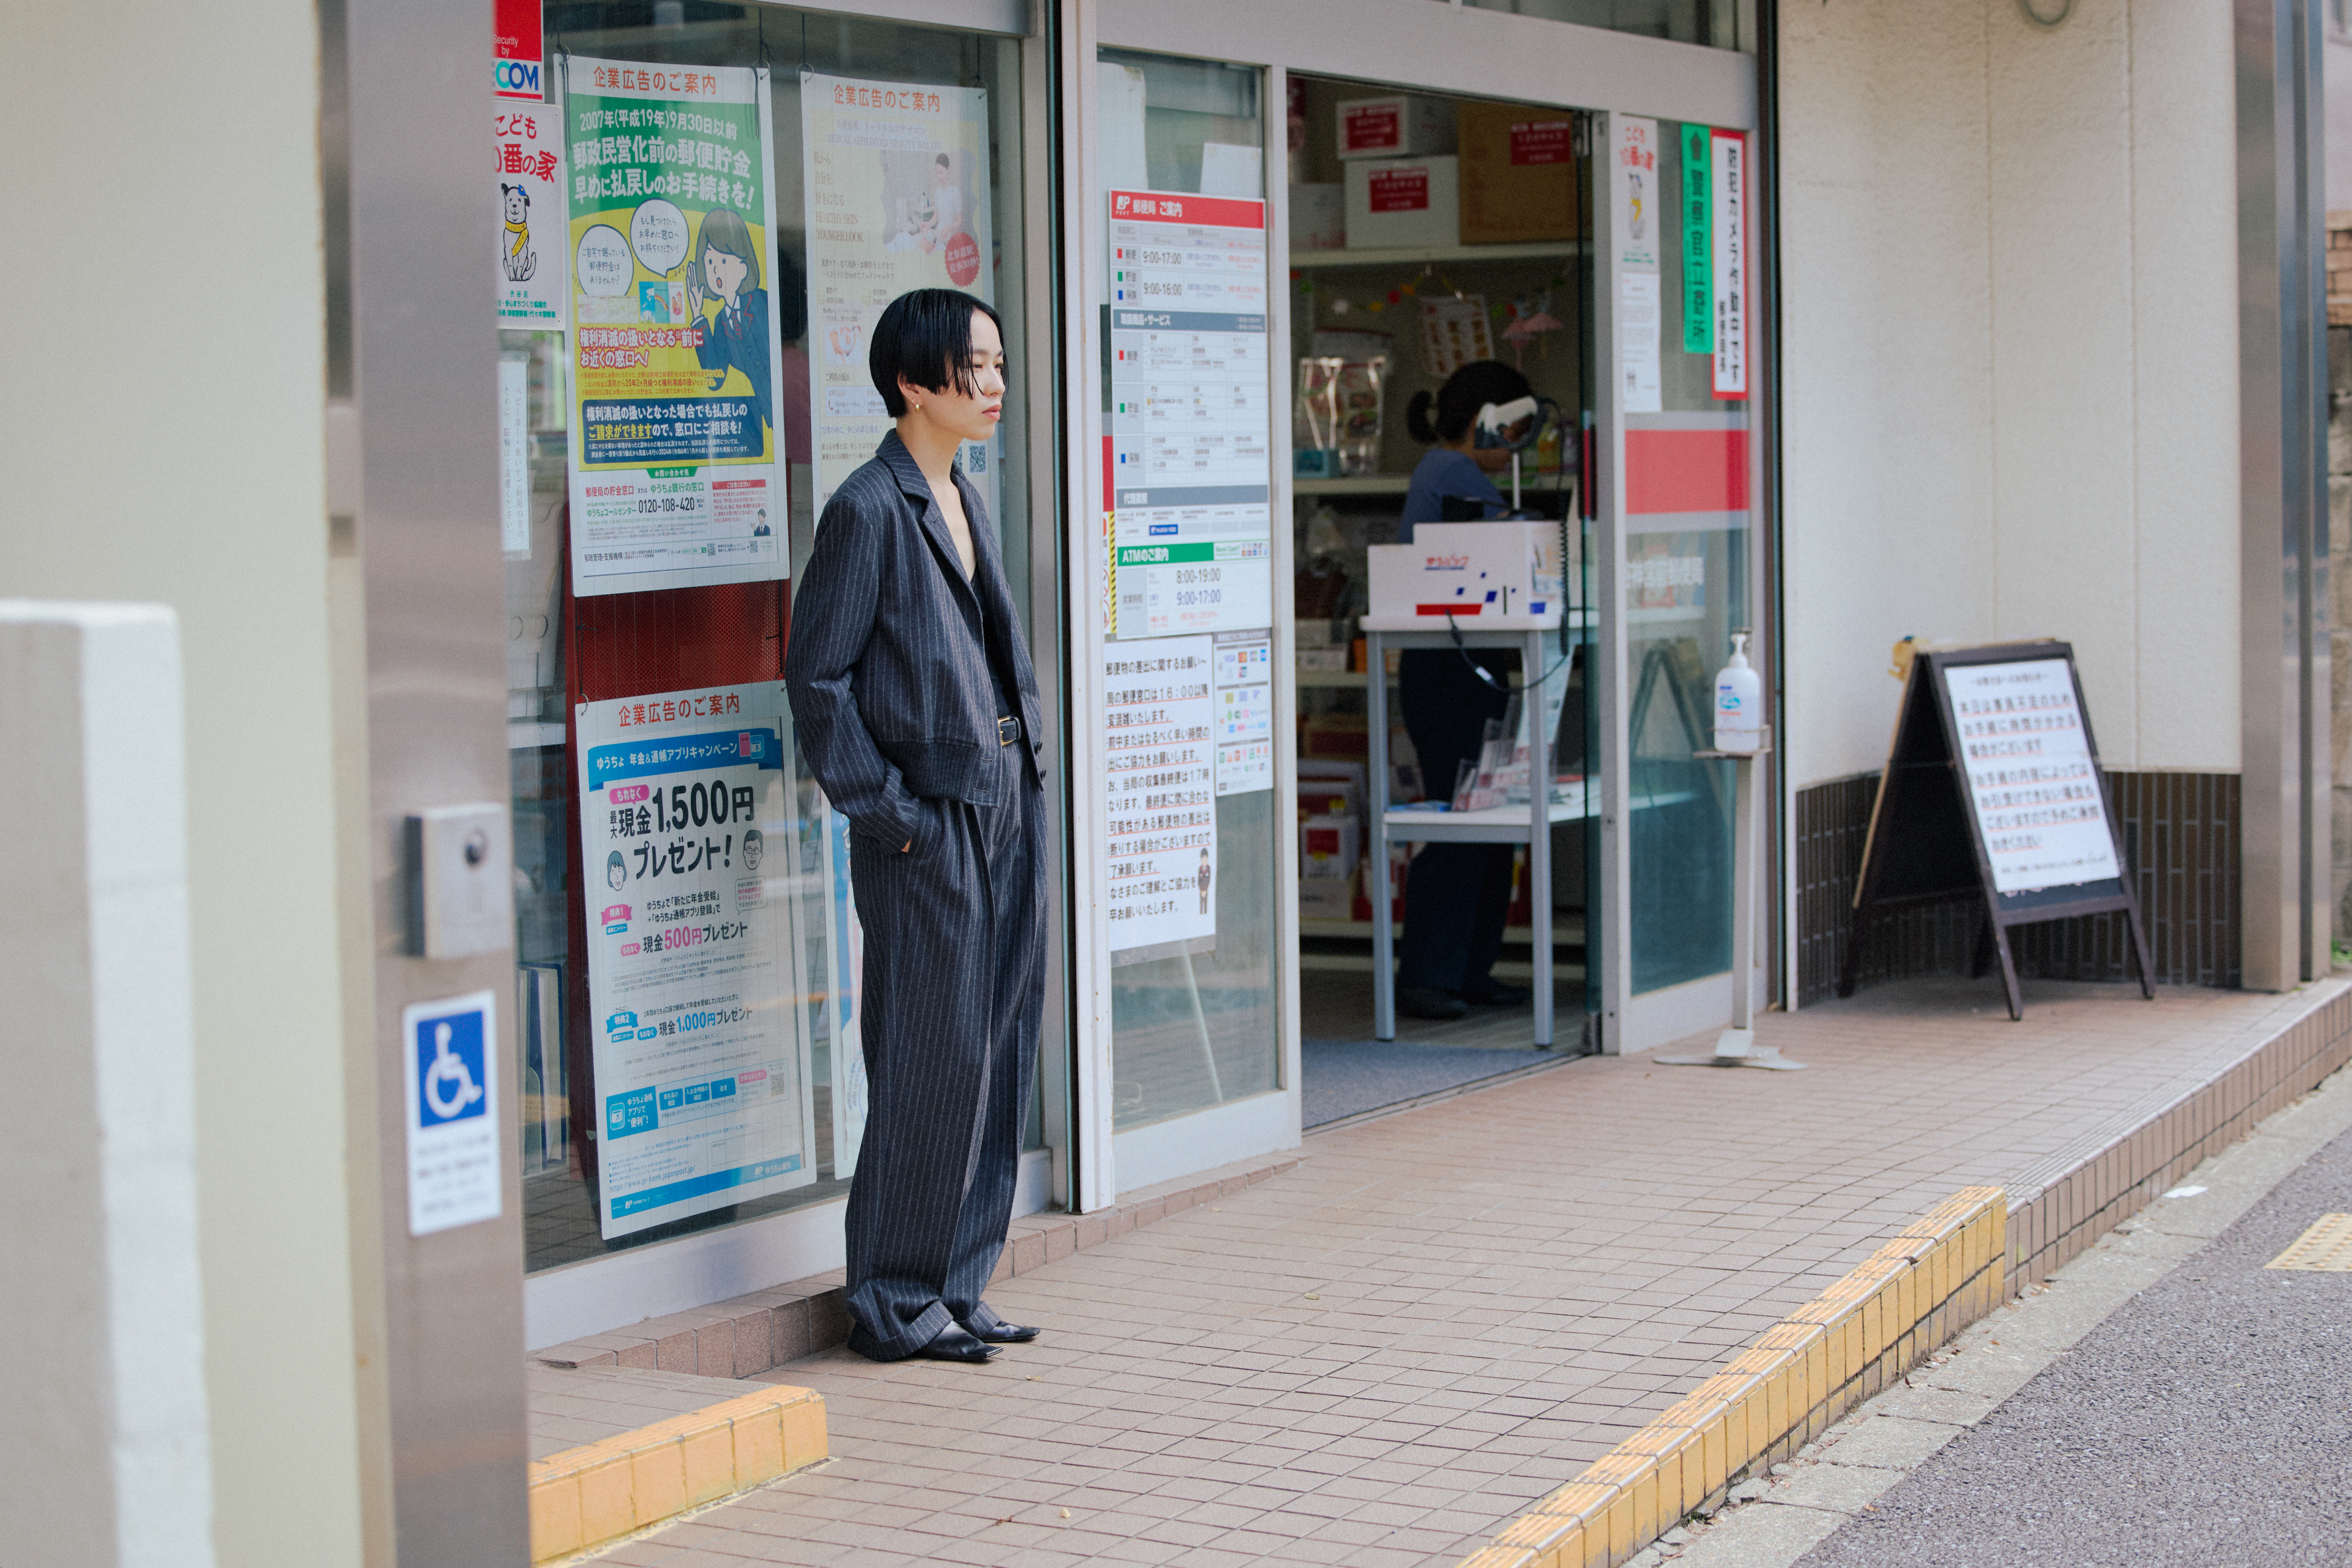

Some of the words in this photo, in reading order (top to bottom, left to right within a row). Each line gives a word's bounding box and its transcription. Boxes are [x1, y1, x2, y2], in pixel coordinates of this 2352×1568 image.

[493, 34, 518, 48] Security
[501, 46, 510, 57] by
[594, 66, 717, 95] 企業広告のご案内
[834, 84, 940, 112] 企業広告のご案内
[494, 113, 537, 139] こども
[580, 109, 738, 140] 2007年(平成19年)9月30日以前
[865, 121, 926, 134] トータルエステサロン
[827, 134, 851, 144] MEDICAL
[853, 135, 889, 147] AFFILIATED
[890, 137, 916, 149] BEAUTY
[918, 140, 942, 150] SALON
[573, 134, 751, 178] 郵政民営化前の郵便貯金
[814, 151, 831, 164] 肌から
[815, 172, 831, 185] 自分を
[575, 168, 754, 210] 早めに払戻しのお手続きを!
[815, 191, 845, 206] 好きになる
[1133, 199, 1156, 215] 郵便局
[1160, 201, 1182, 218] ご案内
[641, 215, 676, 226] もし見つけたら
[816, 212, 843, 224] HEALTHY
[843, 214, 858, 225] SKIN
[639, 229, 679, 240] お早めに窓口へ
[816, 230, 845, 242] YOUNGER
[845, 230, 864, 243] LOOK
[582, 247, 625, 258] ご自宅で眠っている
[640, 243, 679, 253] お持ちください!
[947, 245, 974, 261] 北参道駅
[1125, 249, 1136, 260] 郵便
[1143, 251, 1182, 265] 9:00-17:00
[589, 261, 620, 272] 郵便貯金は
[590, 275, 620, 285] ありませんか?
[1125, 271, 1137, 282] 貯金
[1143, 282, 1182, 296] 9:00-16:00
[1126, 290, 1137, 300] 保険
[496, 300, 547, 308] 全・安心まちづくり協議会
[580, 350, 649, 368] お近くの窓口へ!
[1127, 350, 1138, 361] 郵便
[825, 373, 850, 381] ご利用の流れ
[587, 403, 747, 422] 権利消滅の扱いとなった場合でも払戻しの
[1128, 403, 1139, 413] 貯金
[588, 422, 742, 438] ご請求ができますので、窓口にご相談を!
[654, 468, 689, 477] お問い合わせ先
[586, 485, 634, 497] 郵便局の貯金窓口
[651, 482, 704, 494] ゆうちょ銀行の窓口
[587, 507, 637, 517] ゆうちょコールセンター
[639, 497, 695, 514] 0120-108-420
[1122, 547, 1169, 563] ATMのご案内
[1176, 568, 1221, 584] 8:00-19:00
[1177, 589, 1221, 606] 9:00-17:00
[619, 693, 740, 727] 企業広告のご案内
[1106, 709, 1170, 727] 変混雑いたします。
[1106, 726, 1210, 749] 前中またはなるべく早い時間の
[597, 755, 625, 770] ゆうちょ
[629, 742, 737, 766] 年金&通帳アプリキャンペーン
[1108, 749, 1199, 771] 出にご協力をお願いします。
[617, 788, 642, 800] もれなく
[1108, 790, 1209, 812] なります。最終便に間に合わな
[619, 780, 755, 838] 現金1,500円
[610, 810, 617, 839] 最大
[1109, 811, 1210, 835] 可能性がある郵便物の差出は
[634, 834, 732, 880] プレゼント!
[1109, 861, 1157, 880] 了承願います。
[1110, 877, 1195, 899] なさまのご理解とご協力を
[647, 890, 720, 911] ゆうちょで「新たに年金受給」
[609, 907, 624, 918] 特典1
[607, 925, 627, 934] 自動エントリー
[643, 921, 748, 953] 現金500円プレゼント
[622, 944, 638, 954] もれなく
[614, 1014, 629, 1025] 特典2
[659, 1007, 753, 1037] 現金1,000円プレゼント
[612, 1033, 633, 1042] 自動エントリー
[639, 1028, 654, 1039] もれなく
[664, 1091, 678, 1101] 現在高の
[686, 1085, 709, 1095] 入出金明細の
[627, 1092, 653, 1105] ゆうちょ通帳
[627, 1106, 646, 1115] アプリで
[765, 1161, 791, 1175] ゆうちょ銀行
[610, 1165, 695, 1193] https://www.jp-bank.japanpost.jp/
